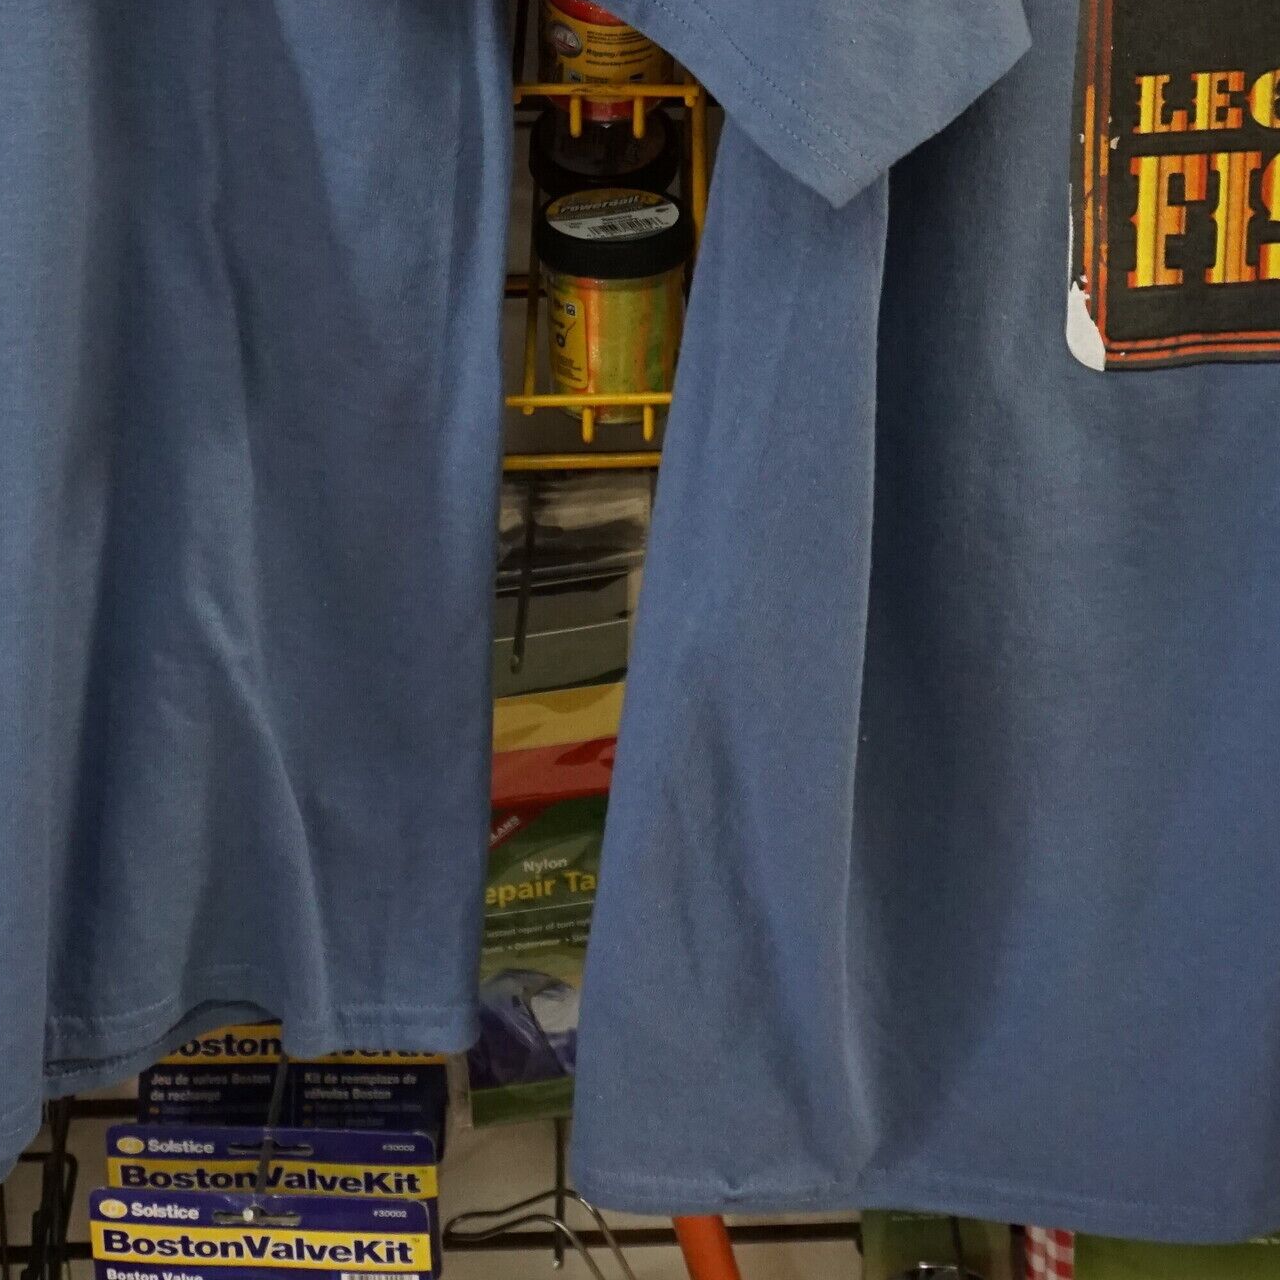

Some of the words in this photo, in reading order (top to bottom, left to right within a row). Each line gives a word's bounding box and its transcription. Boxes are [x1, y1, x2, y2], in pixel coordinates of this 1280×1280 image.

[523, 858, 568, 877] Nylon
[179, 1033, 282, 1057] oston
[147, 1140, 215, 1154] Solstice
[120, 1164, 421, 1195] BostonValveKit
[131, 1203, 200, 1220] Solstice
[103, 1228, 413, 1265] BostonValveKit
